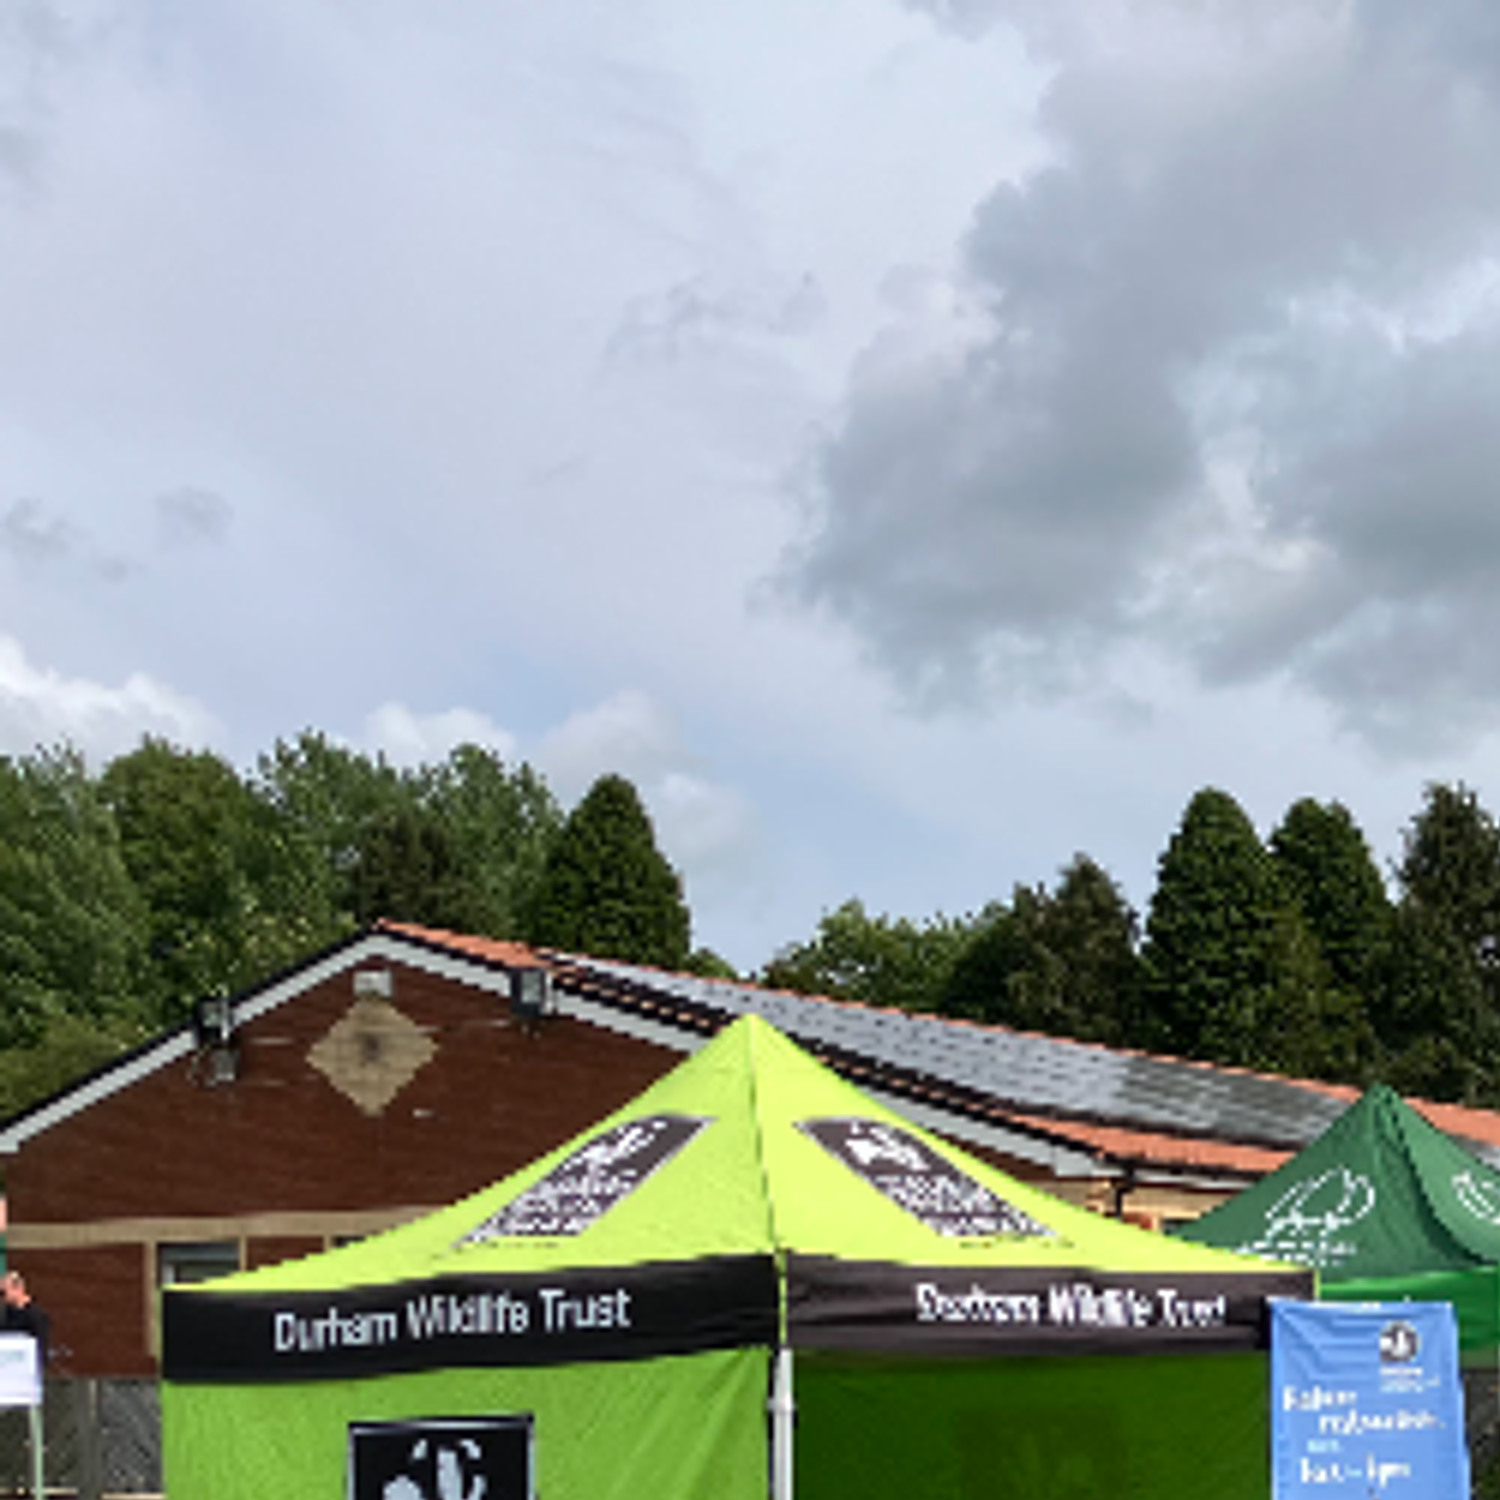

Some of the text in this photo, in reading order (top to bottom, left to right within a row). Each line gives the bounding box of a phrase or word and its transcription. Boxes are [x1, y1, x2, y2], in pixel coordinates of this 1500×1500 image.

[274, 1287, 632, 1351] Durham Wildlife Trust
